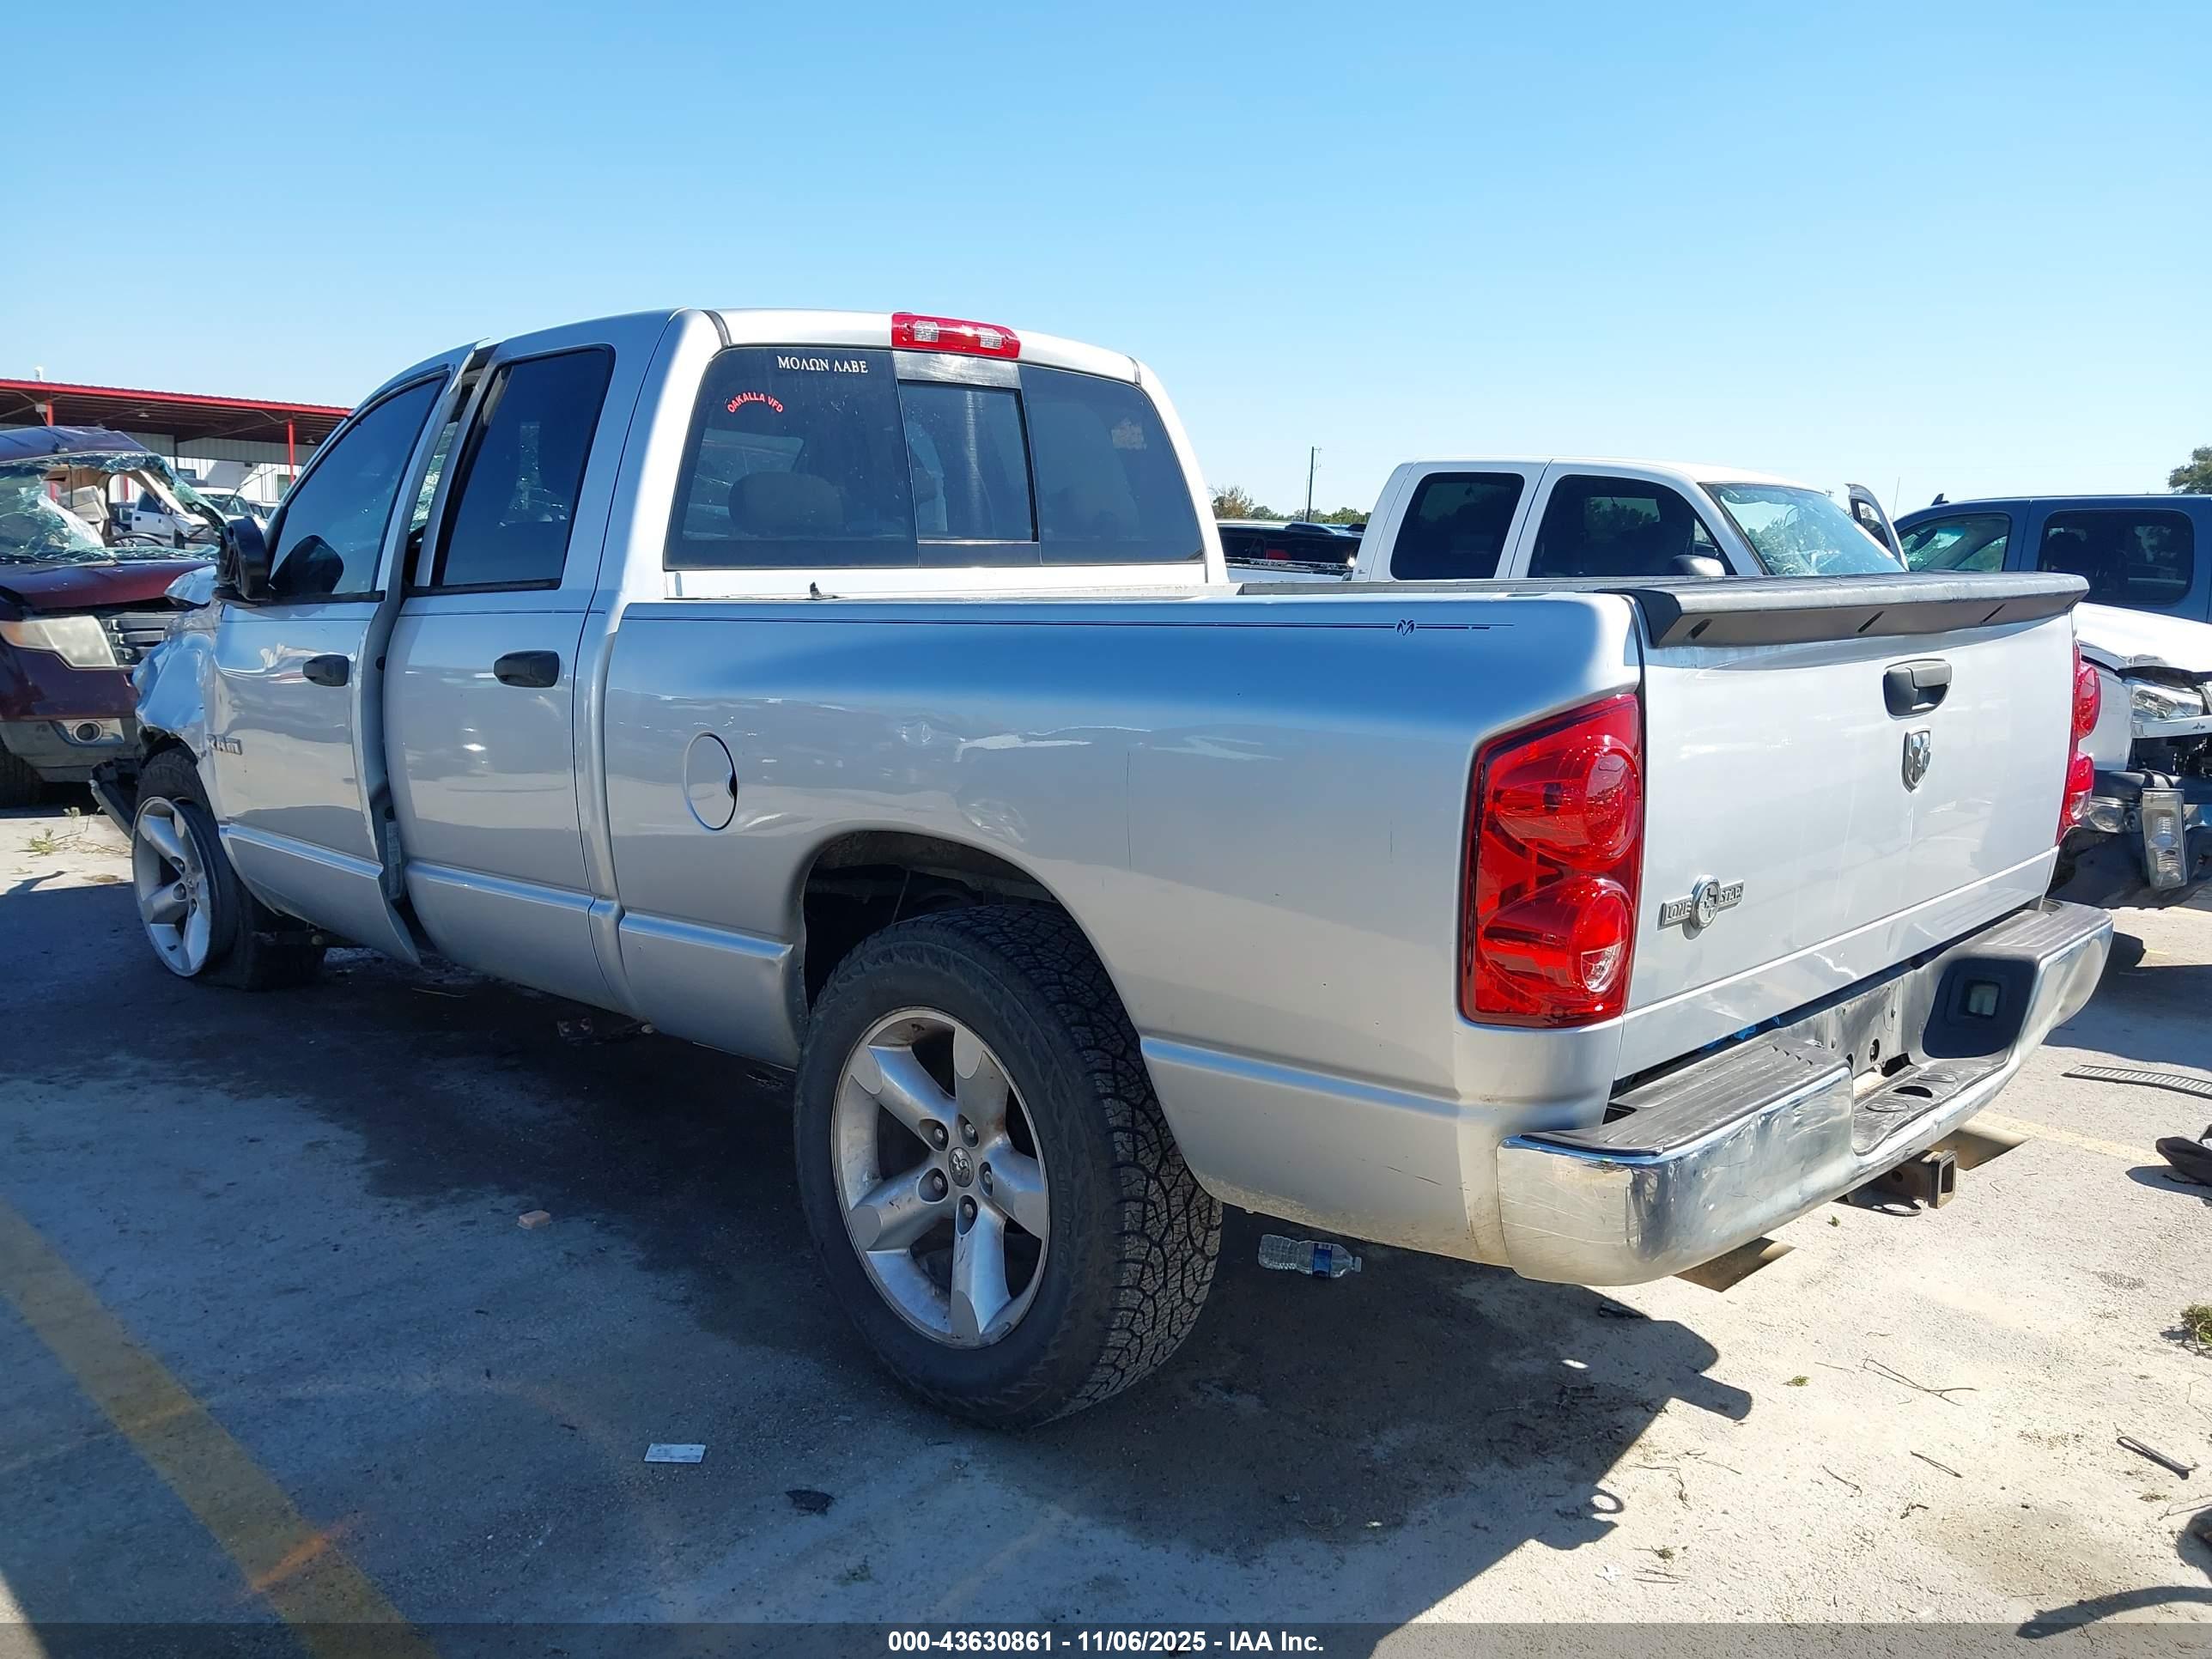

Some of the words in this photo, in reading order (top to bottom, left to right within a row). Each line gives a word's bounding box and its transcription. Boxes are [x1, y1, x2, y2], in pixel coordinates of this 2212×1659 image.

[727, 392, 765, 413] OAKALLA
[768, 396, 783, 412] VFD
[1720, 885, 1742, 902] STAR
